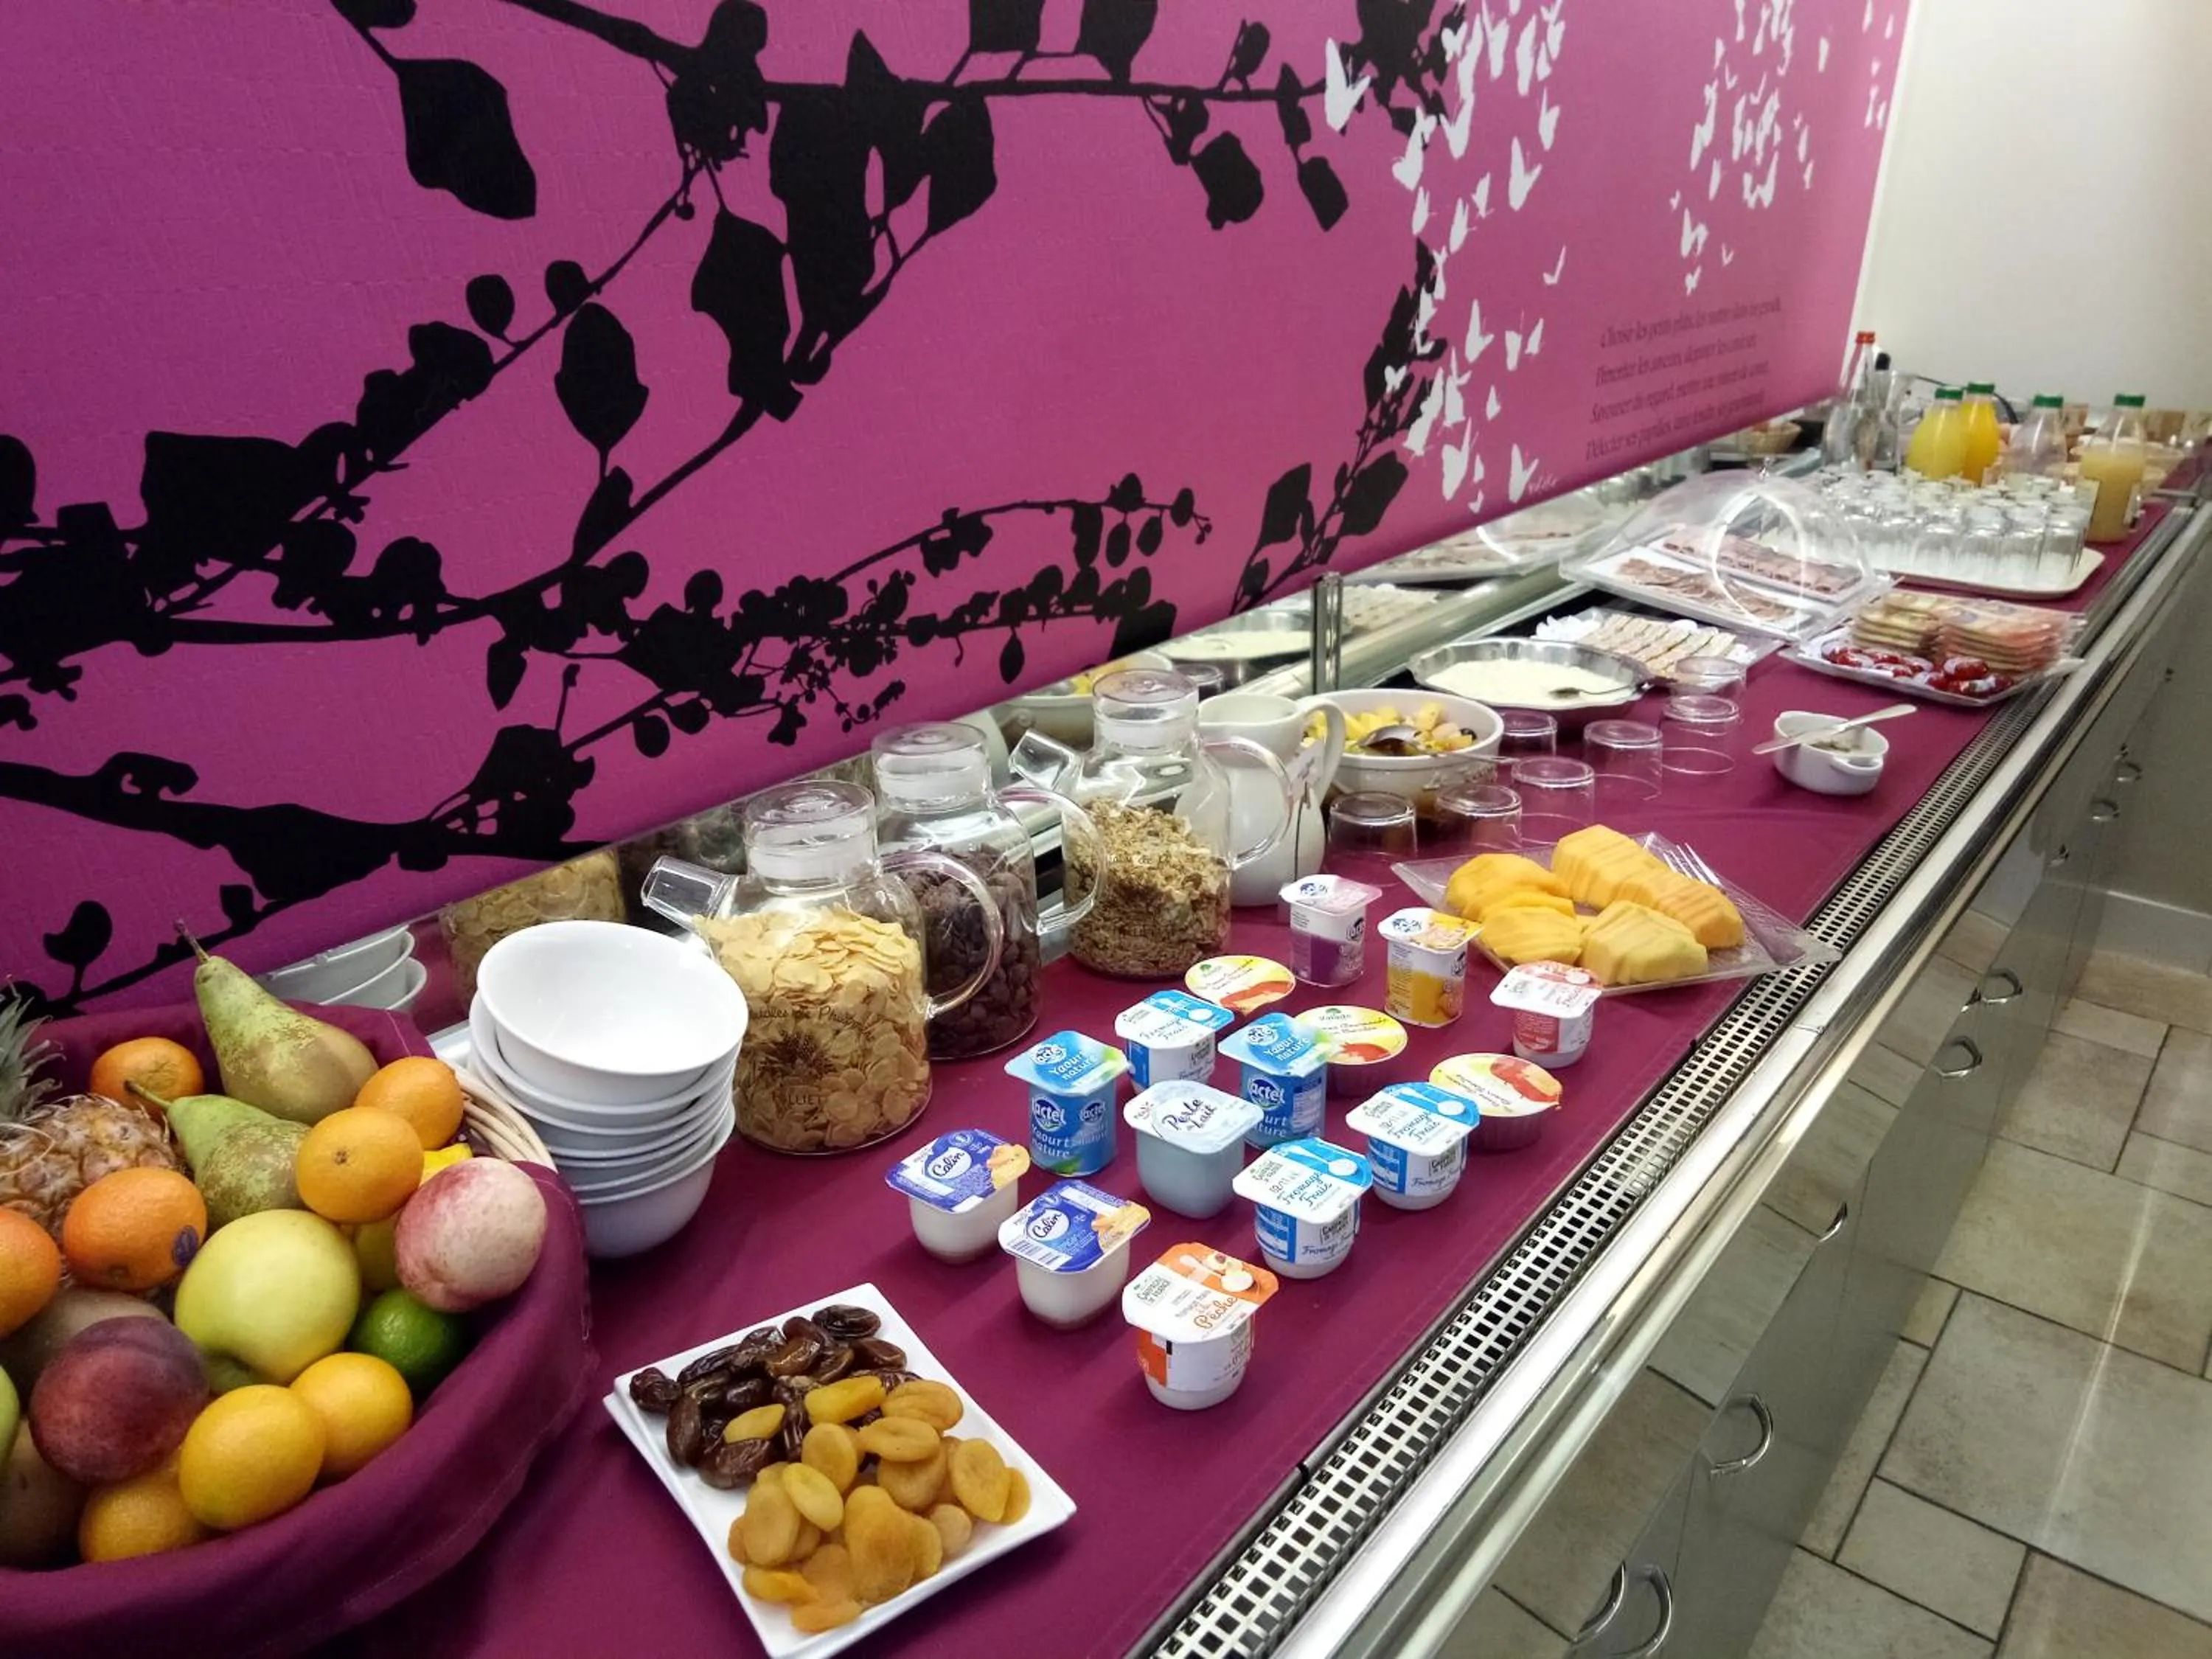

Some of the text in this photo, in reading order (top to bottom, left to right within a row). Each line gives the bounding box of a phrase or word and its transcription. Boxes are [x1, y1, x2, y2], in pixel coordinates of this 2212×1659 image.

[1161, 1098, 1203, 1132] Perle
[932, 1151, 966, 1178] Calin
[1032, 1211, 1062, 1239] Calin
